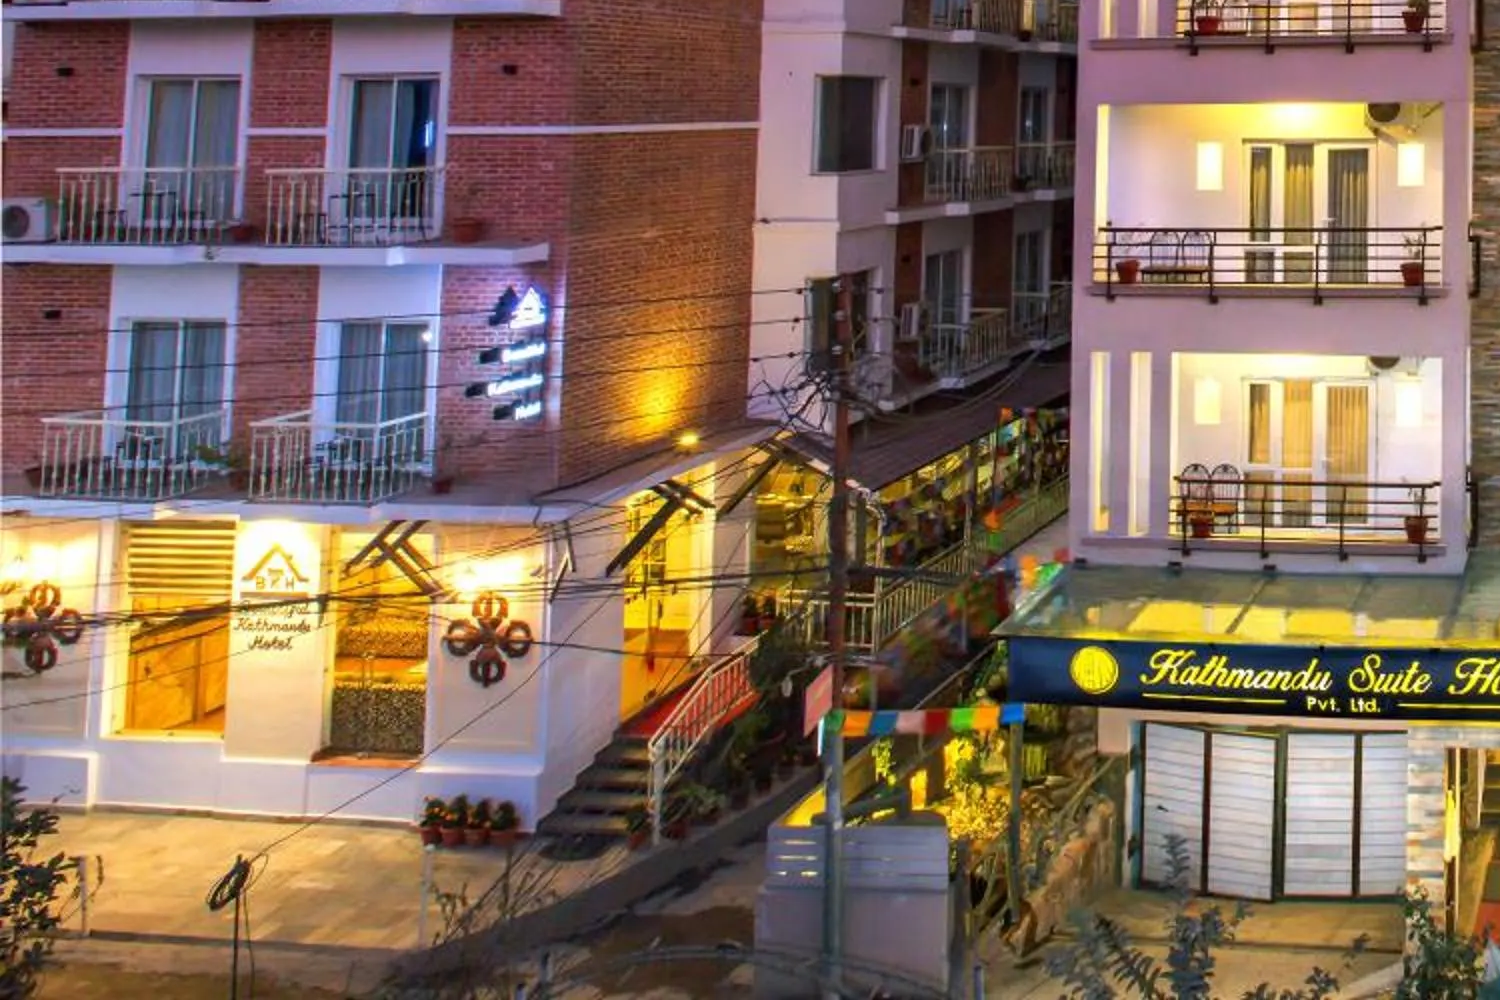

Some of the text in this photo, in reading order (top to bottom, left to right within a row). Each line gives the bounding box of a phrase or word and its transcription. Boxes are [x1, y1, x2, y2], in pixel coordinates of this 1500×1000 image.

[1139, 649, 1333, 692] Kathmandu
[1348, 653, 1433, 695] Suite
[1306, 696, 1381, 713] Pvt. Ltd.
